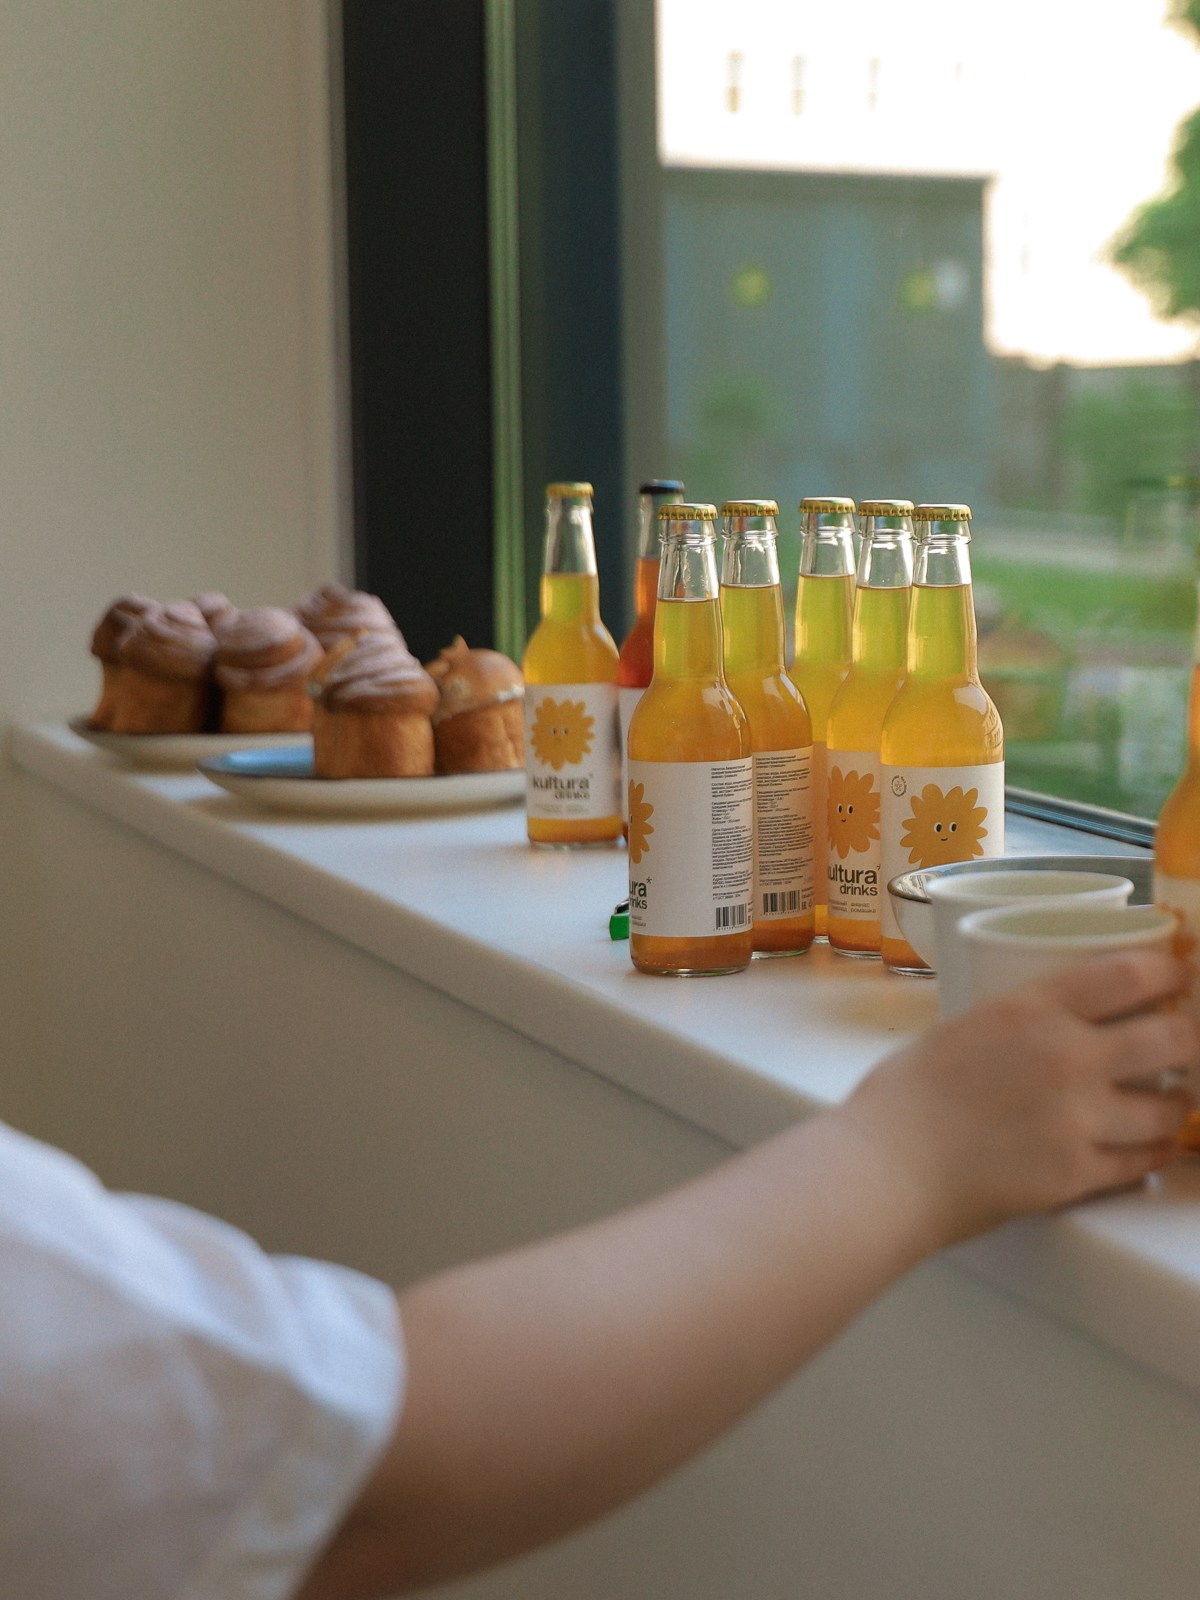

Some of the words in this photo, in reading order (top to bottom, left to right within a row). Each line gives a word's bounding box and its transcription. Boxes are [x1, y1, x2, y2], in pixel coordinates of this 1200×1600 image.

[532, 776, 590, 790] kultura
[828, 864, 877, 884] ultura
[840, 883, 878, 896] drinks
